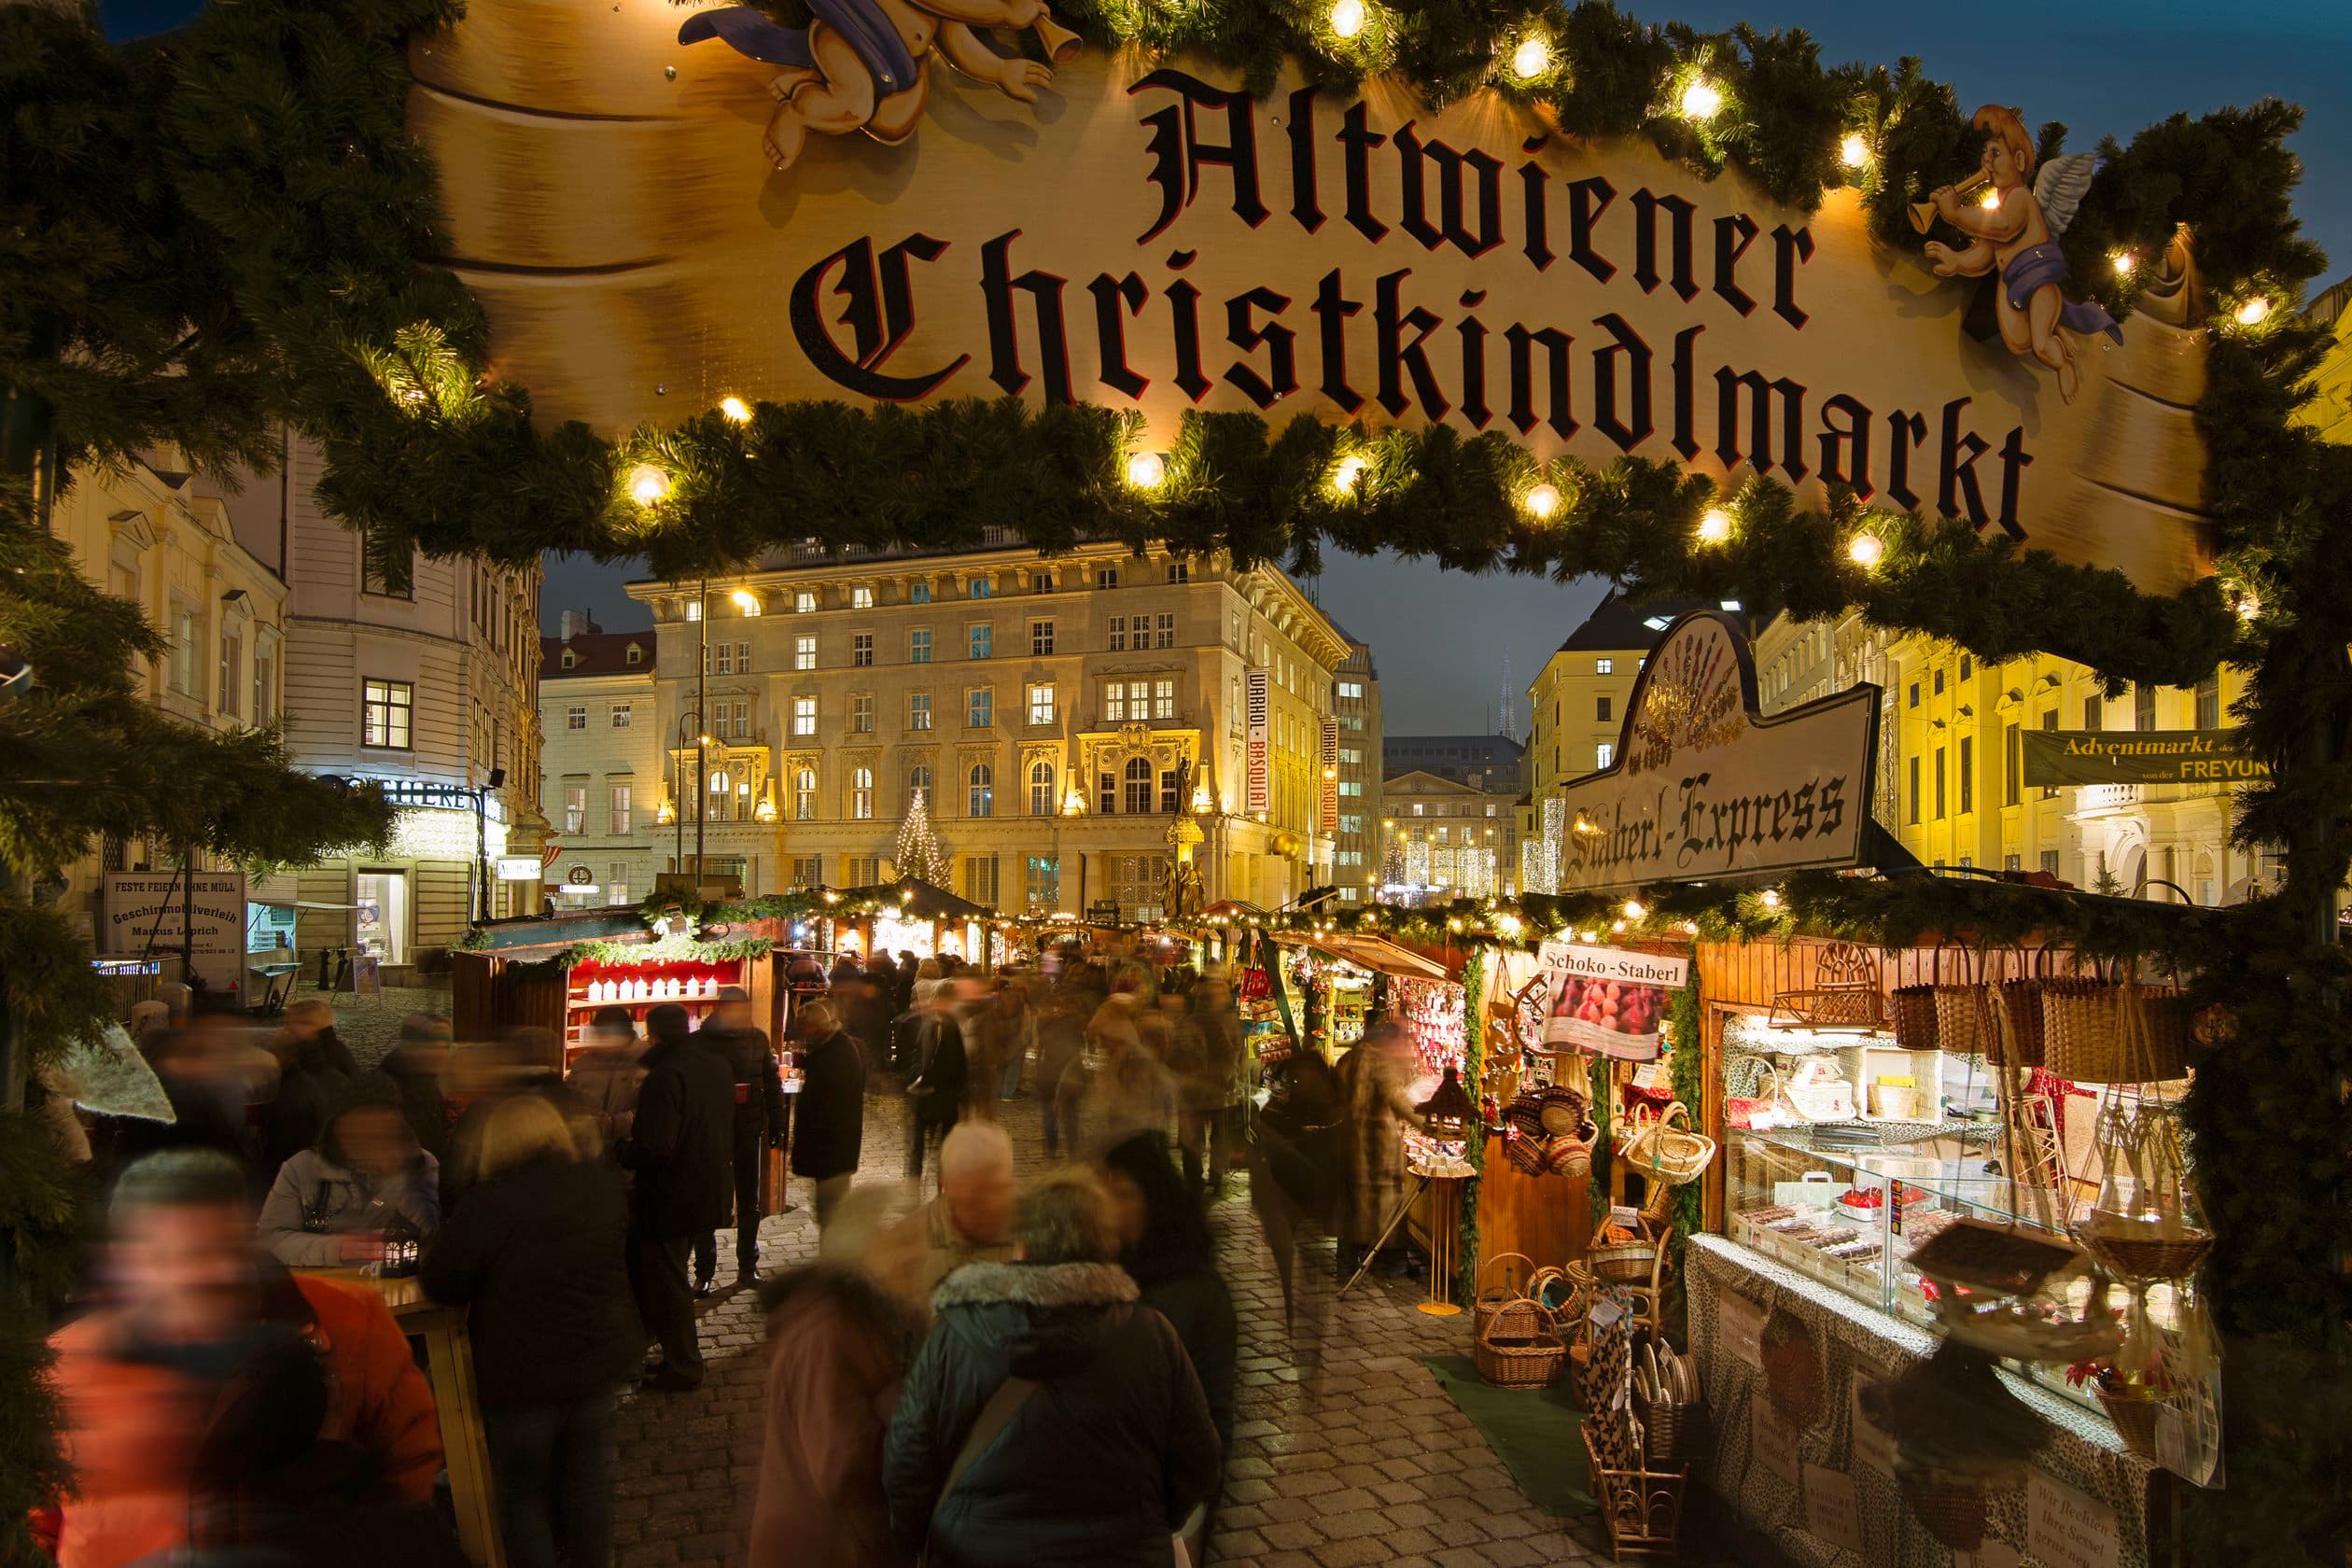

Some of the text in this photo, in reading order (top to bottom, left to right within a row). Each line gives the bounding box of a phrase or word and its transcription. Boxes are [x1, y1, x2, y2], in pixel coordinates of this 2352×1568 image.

[1127, 68, 1815, 330] Altwiener
[790, 226, 2034, 543] Christkindlmarkt
[1249, 674, 1267, 808] WARHOL BASQUIAT
[2064, 735, 2215, 756] Adventmarkt
[2159, 771, 2174, 780] der
[2180, 760, 2277, 779] FREYUN
[115, 881, 145, 892] FESTE
[184, 881, 208, 892] HNE
[210, 880, 235, 892] MÜLL
[113, 903, 237, 925] Geschirmoblverleih
[2038, 1485, 2059, 1507] Wir
[2041, 1508, 2106, 1558] Ihre Sessel
